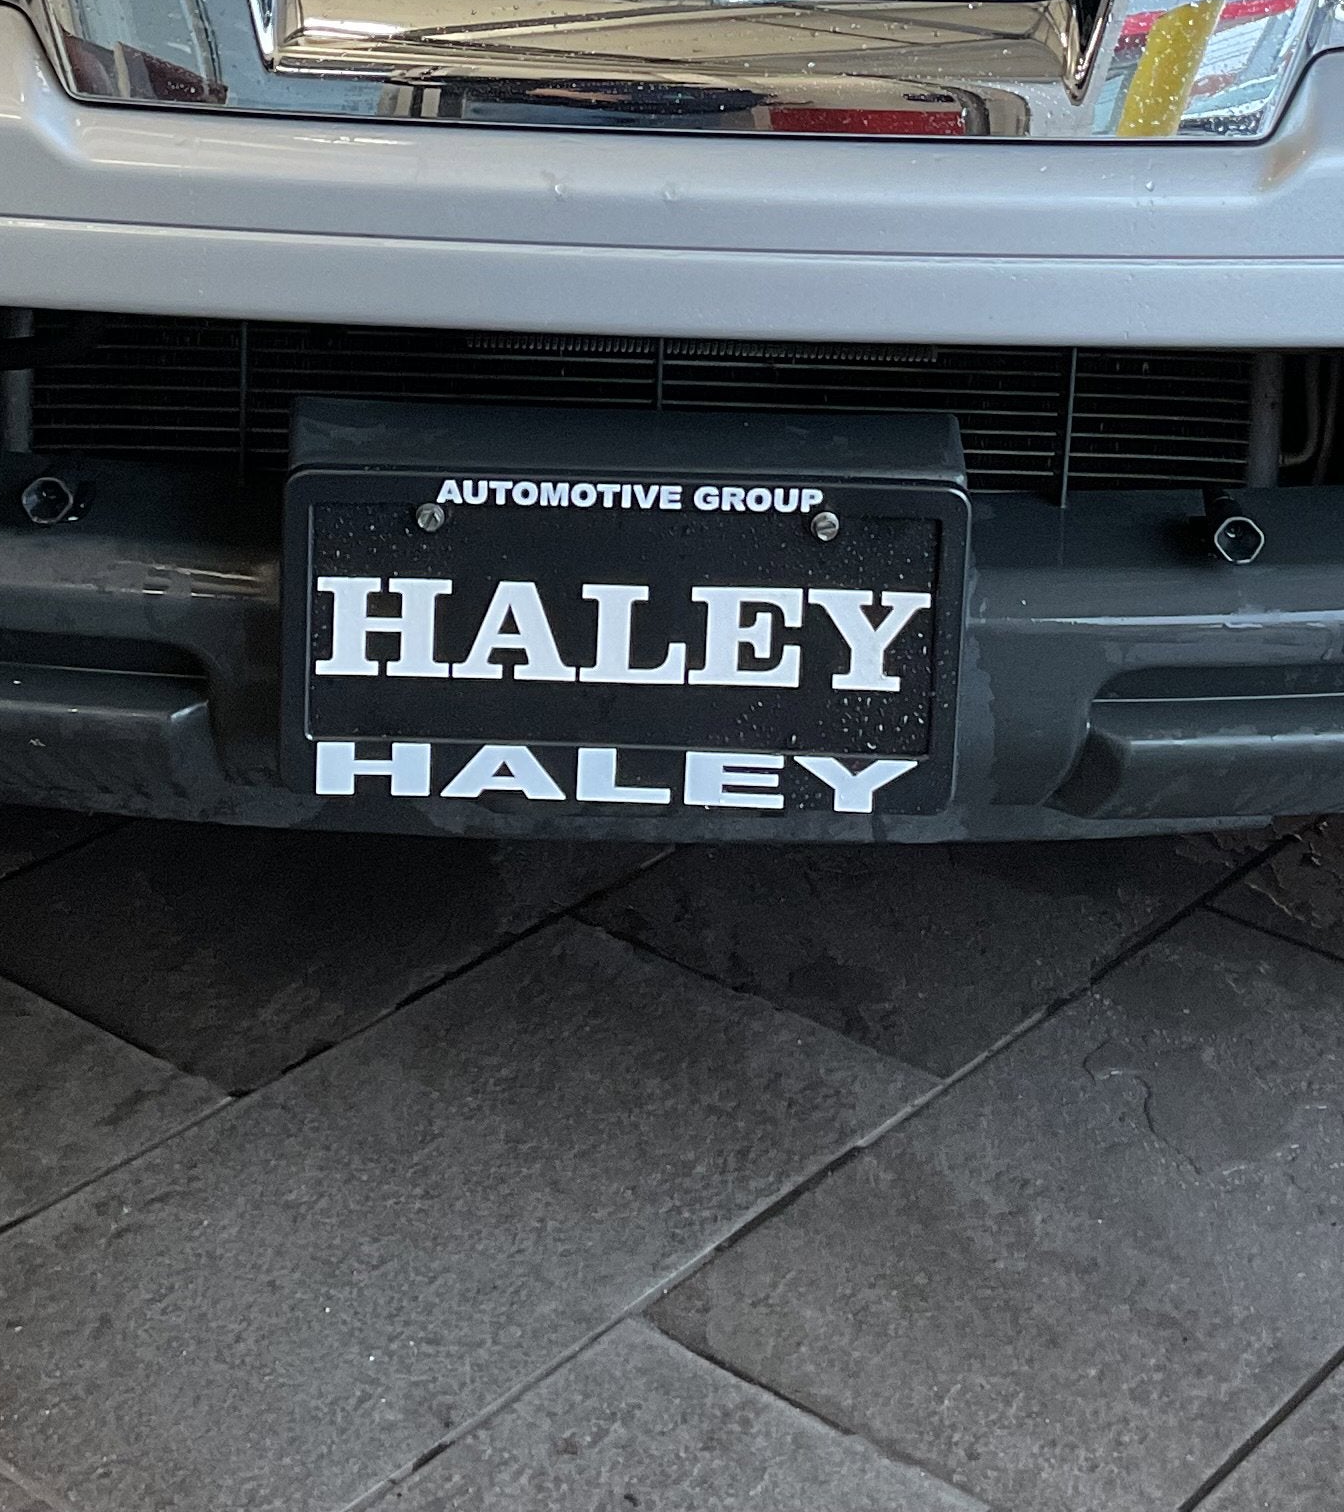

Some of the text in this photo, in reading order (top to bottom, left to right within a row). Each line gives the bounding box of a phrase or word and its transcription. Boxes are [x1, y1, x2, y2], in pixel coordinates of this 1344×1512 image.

[436, 479, 824, 513] AUTOMOTIVE GROUP
[315, 576, 932, 692] HALEY
[315, 741, 918, 813] HALEY
